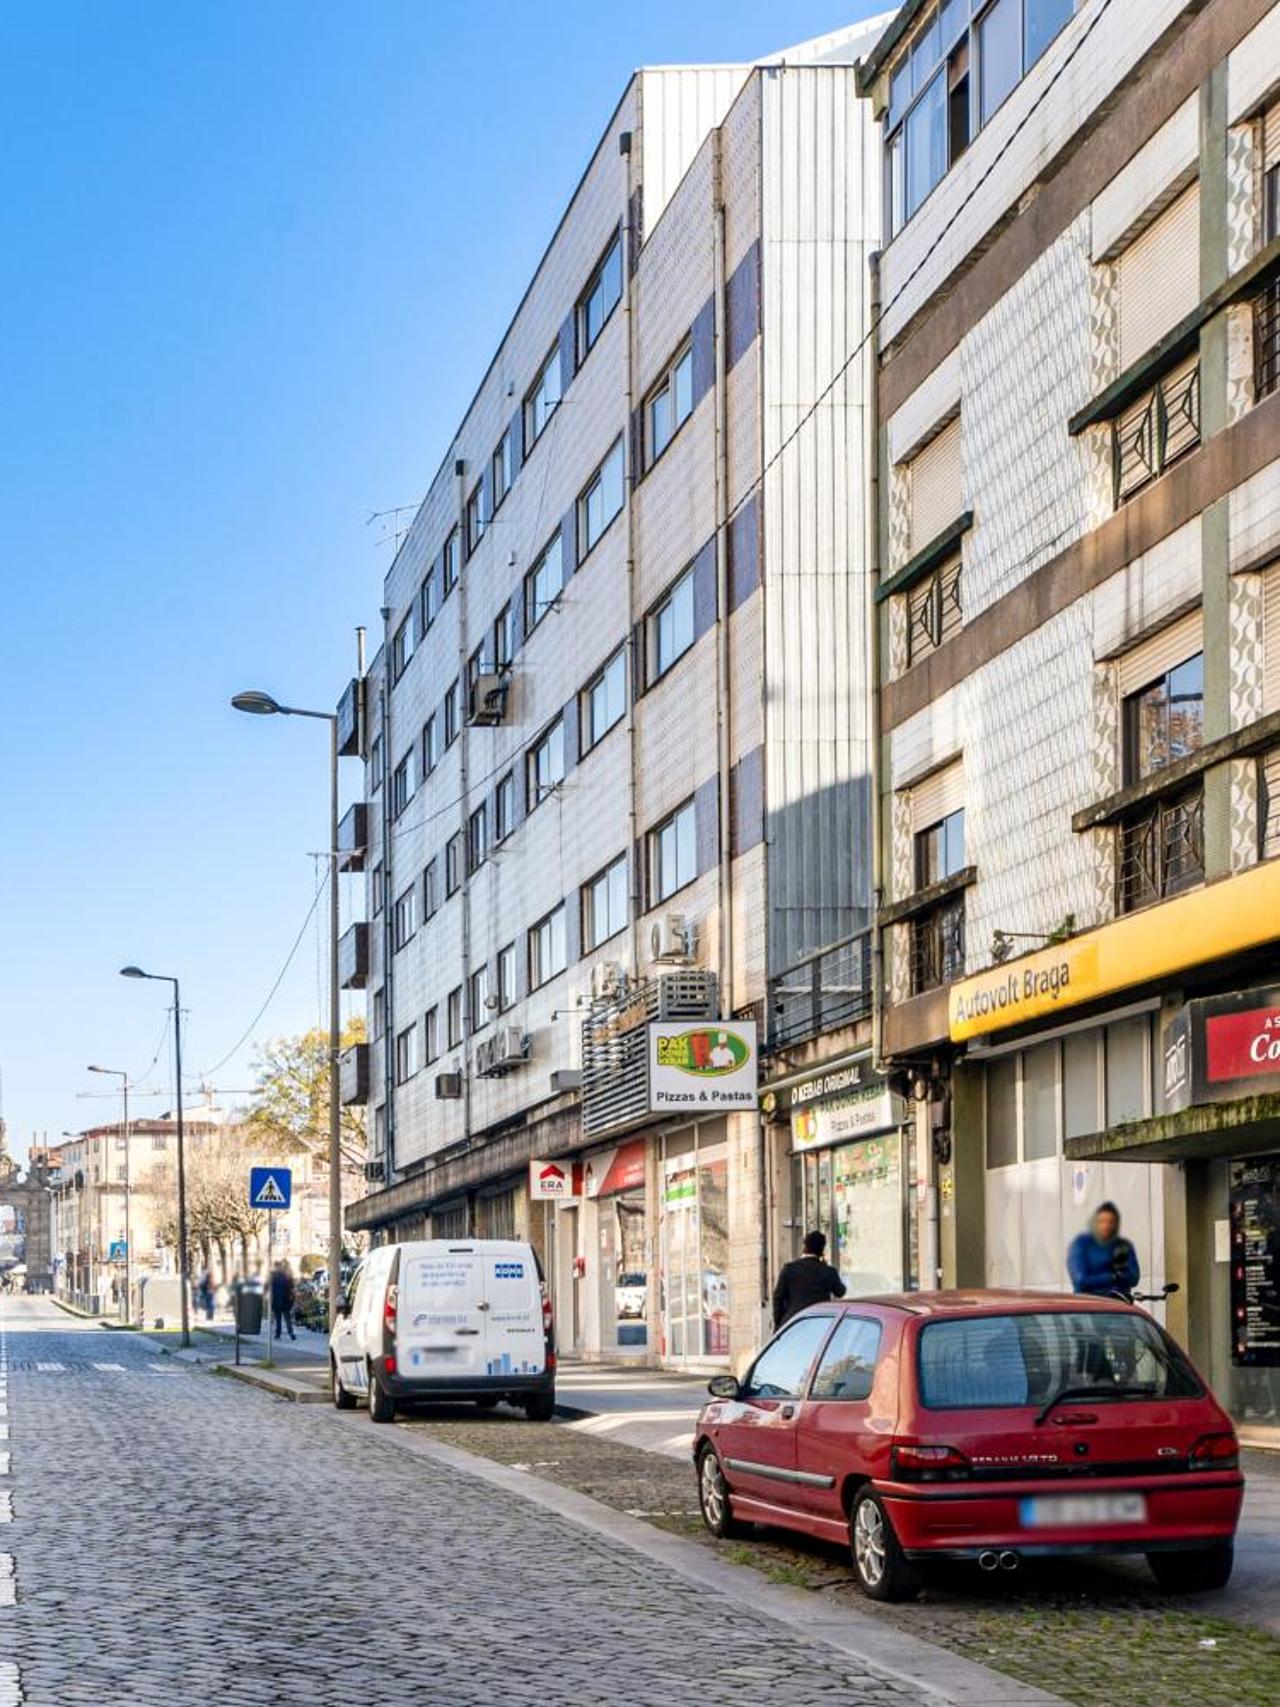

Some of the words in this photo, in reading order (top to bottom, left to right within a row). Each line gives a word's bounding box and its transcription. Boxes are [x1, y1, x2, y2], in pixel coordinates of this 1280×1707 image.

[955, 973, 1020, 1024] Autovolt
[1023, 961, 1070, 999] Braga
[657, 1036, 688, 1050] PAK
[656, 1092, 695, 1101] Pizzas
[699, 1091, 708, 1101] &
[711, 1091, 753, 1101] Pastas
[791, 1088, 798, 1105] O
[798, 1079, 823, 1102] KEBAB
[824, 1067, 861, 1093] ORIGINAL
